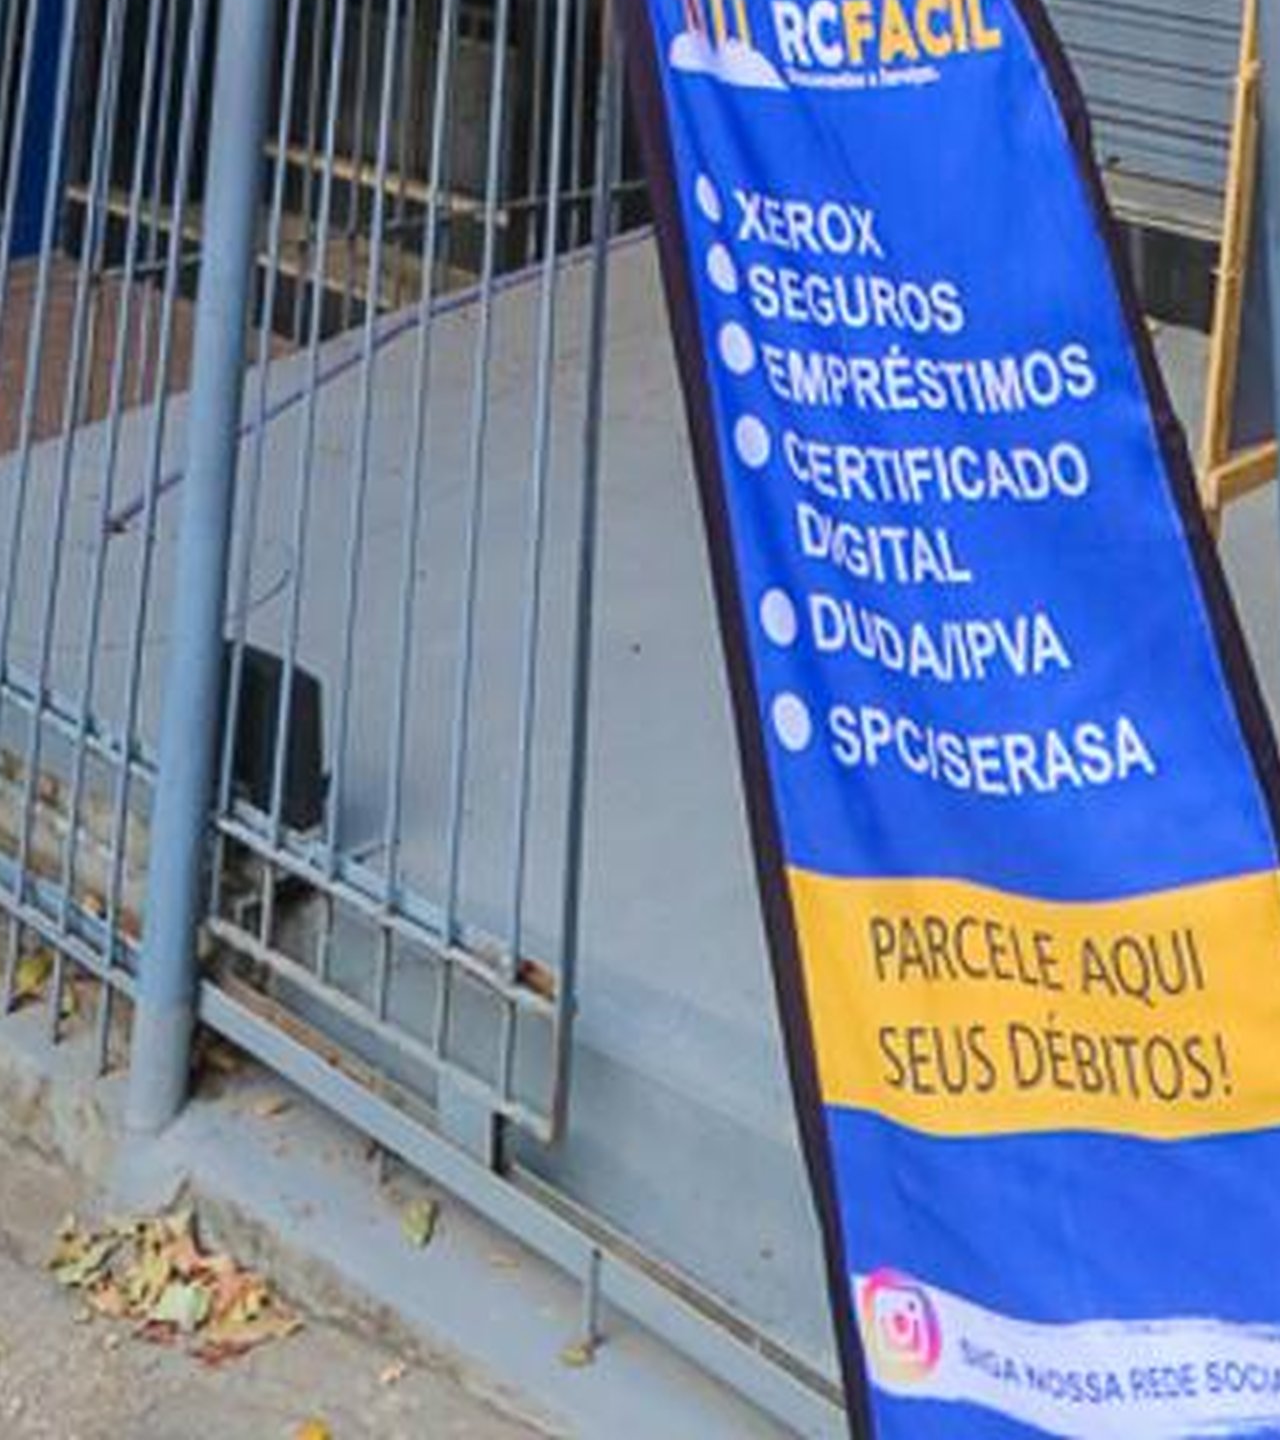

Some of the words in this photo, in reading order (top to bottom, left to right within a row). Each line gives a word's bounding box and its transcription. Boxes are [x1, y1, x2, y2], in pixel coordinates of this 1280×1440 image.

[734, 187, 885, 260] XEROX
[748, 264, 965, 335] SEGUROS
[760, 342, 1097, 414] EMPRÉSTIMOS
[782, 429, 1090, 502] CERTIFICADO
[795, 502, 971, 583] DIGITAL
[808, 592, 1072, 681] DUDA/IPVA
[869, 915, 1066, 992] PARCELE
[1080, 927, 1206, 1008] AQUI
[877, 1024, 997, 1096] SEUS
[1008, 1011, 1234, 1102] DÉBITOS!
[1024, 1365, 1125, 1404] NOSSA
[1128, 1362, 1199, 1401] REDE
